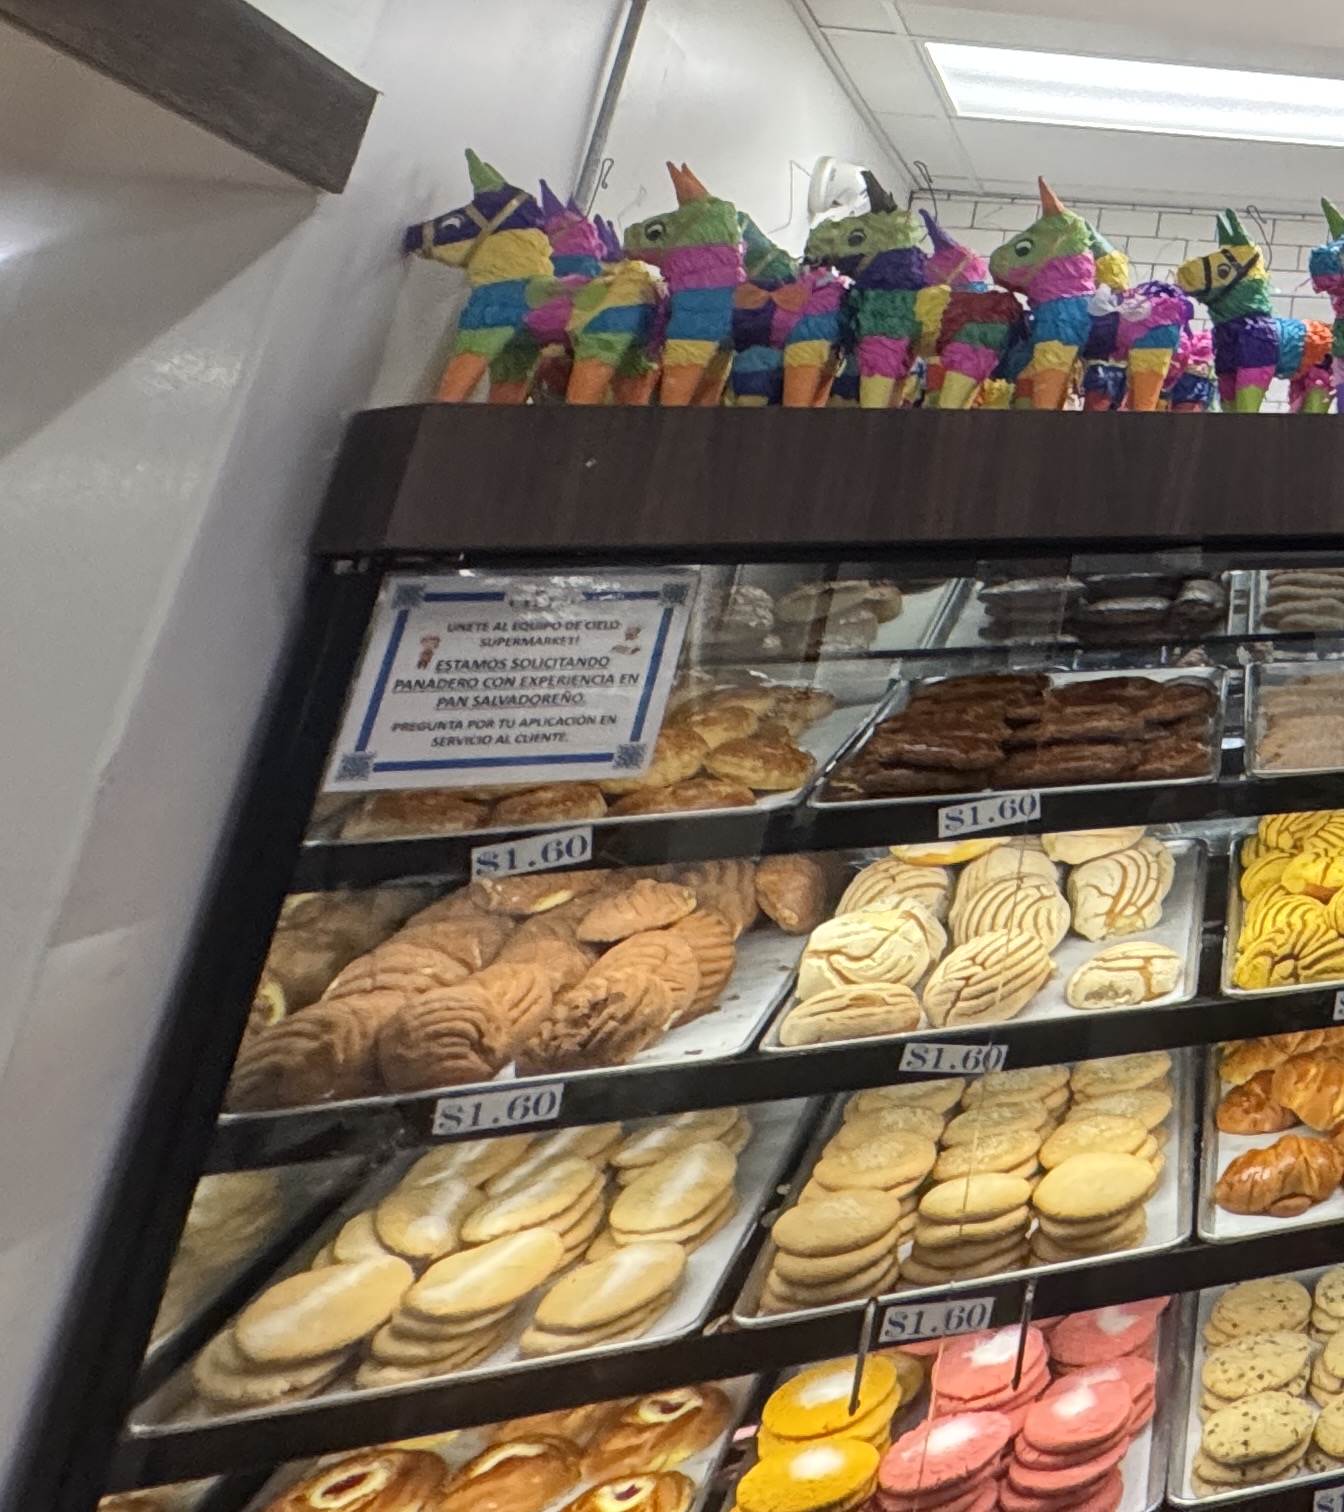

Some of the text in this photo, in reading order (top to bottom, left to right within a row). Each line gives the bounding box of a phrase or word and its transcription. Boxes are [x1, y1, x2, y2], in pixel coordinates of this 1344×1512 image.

[493, 621, 508, 632] AL
[512, 621, 561, 632] EQUIPO
[565, 620, 580, 630] DE
[479, 634, 580, 647] SUPERMARKET!
[434, 655, 610, 672] ESTAMOS SOLICITANDO
[393, 673, 640, 691] PANADERO CON EXPERIENCIA EN
[436, 694, 469, 709] PAN
[391, 720, 464, 732] PREGUNTA
[467, 719, 495, 730] POR
[499, 718, 516, 729] TU
[600, 714, 618, 726] EN
[430, 734, 492, 747] SERVICIO
[494, 733, 511, 745] AL
[944, 794, 1038, 833] $1.60
[476, 835, 588, 875] $1.60
[907, 1045, 1005, 1071] $1.60
[438, 1089, 560, 1131] $1.60
[883, 1301, 993, 1337] $1.60
